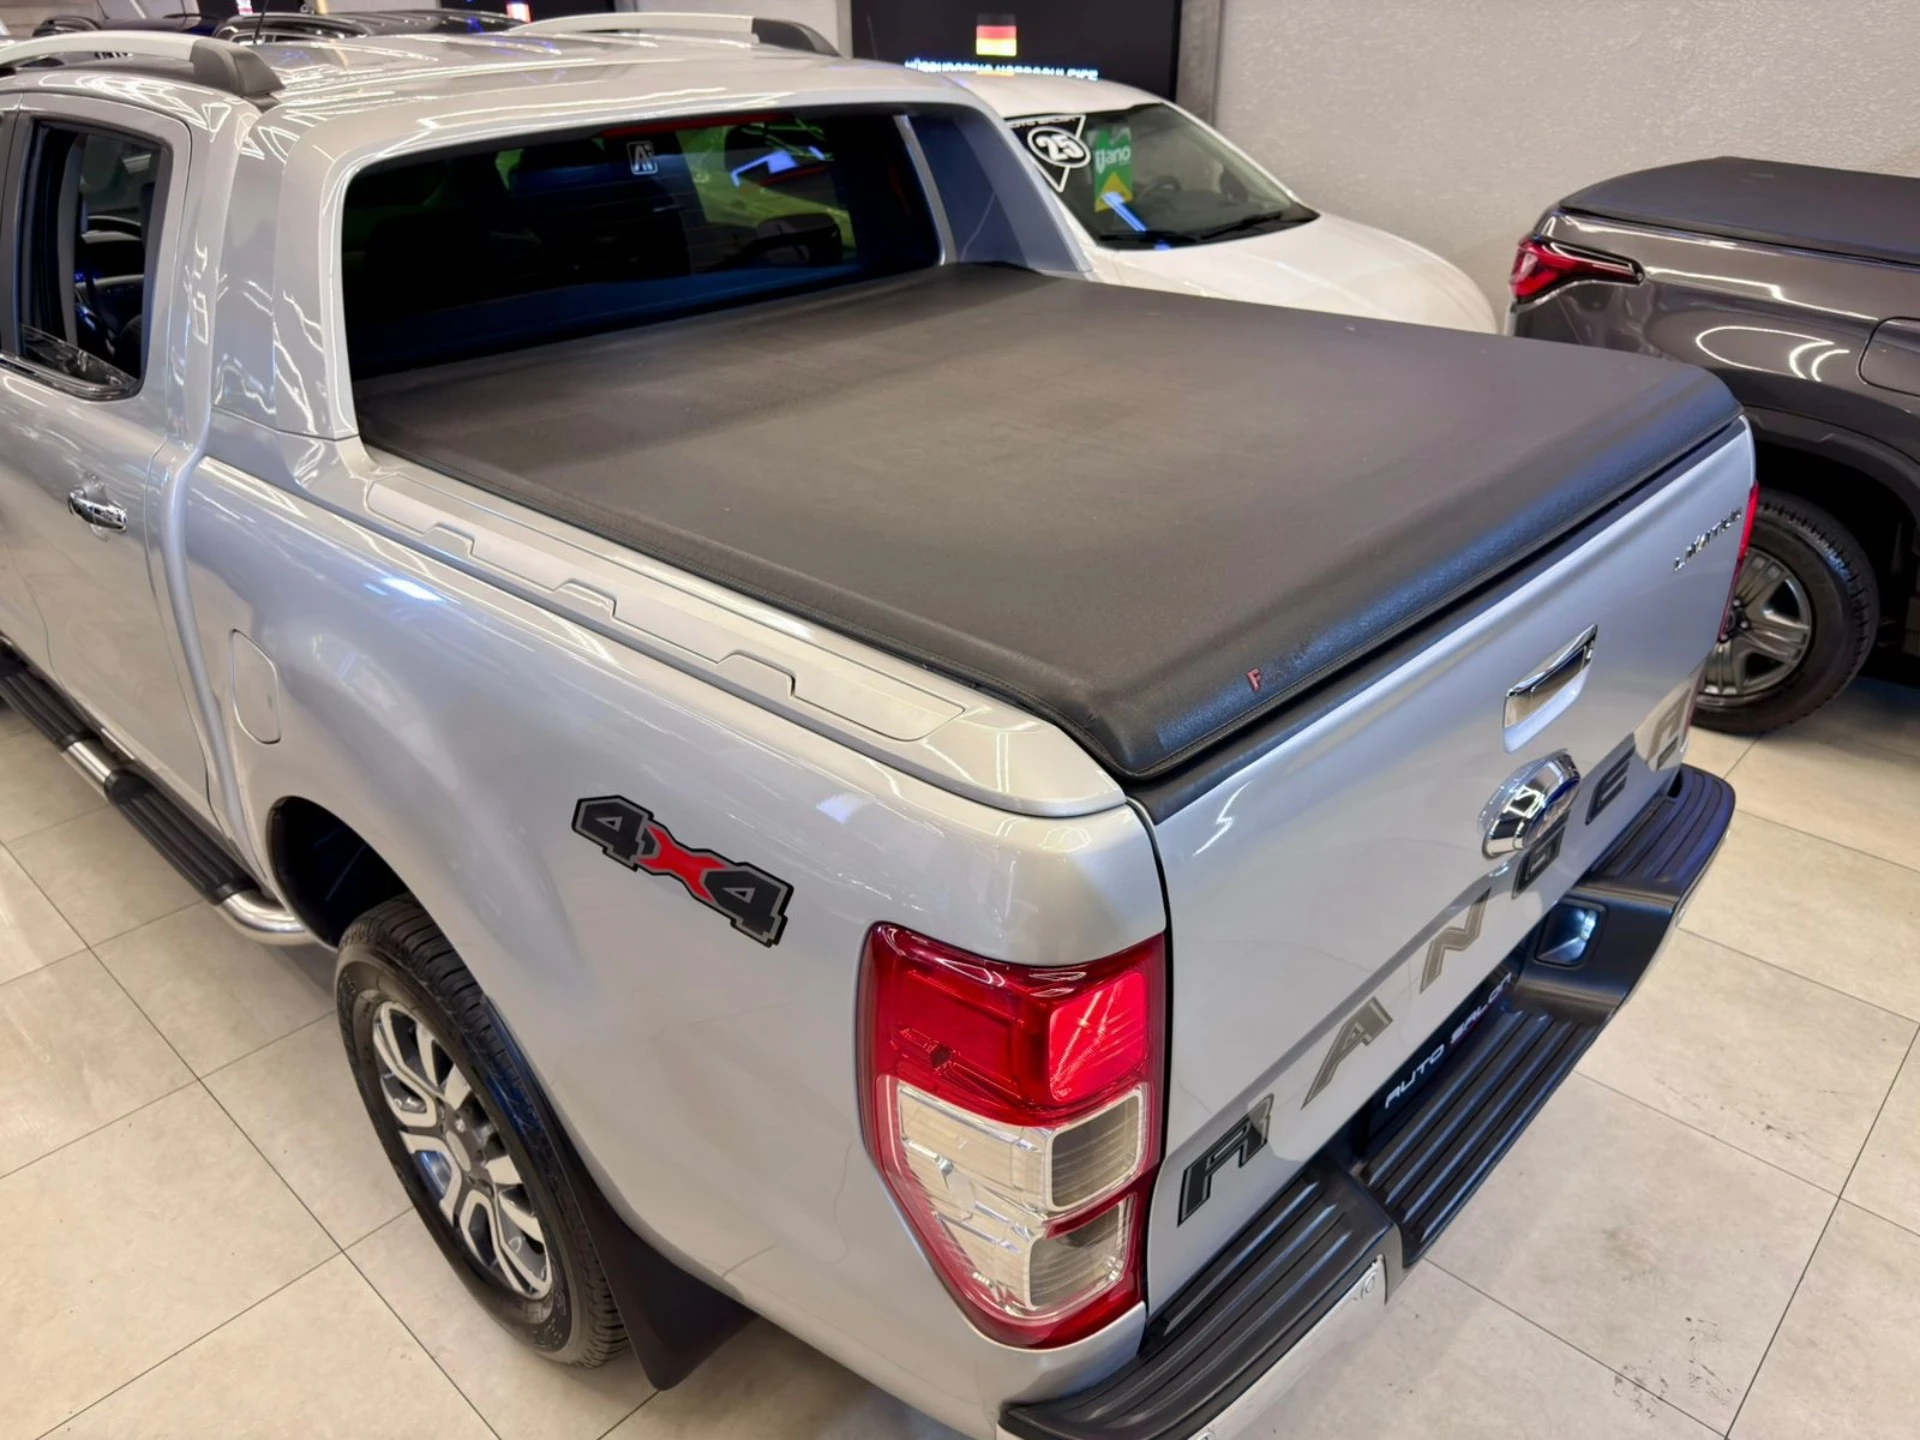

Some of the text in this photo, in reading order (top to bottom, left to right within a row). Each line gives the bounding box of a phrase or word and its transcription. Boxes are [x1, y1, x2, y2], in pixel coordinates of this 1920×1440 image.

[1035, 133, 1086, 162] 25
[1177, 687, 1692, 1228] RANGER
[1384, 1043, 1445, 1110] AUTO
